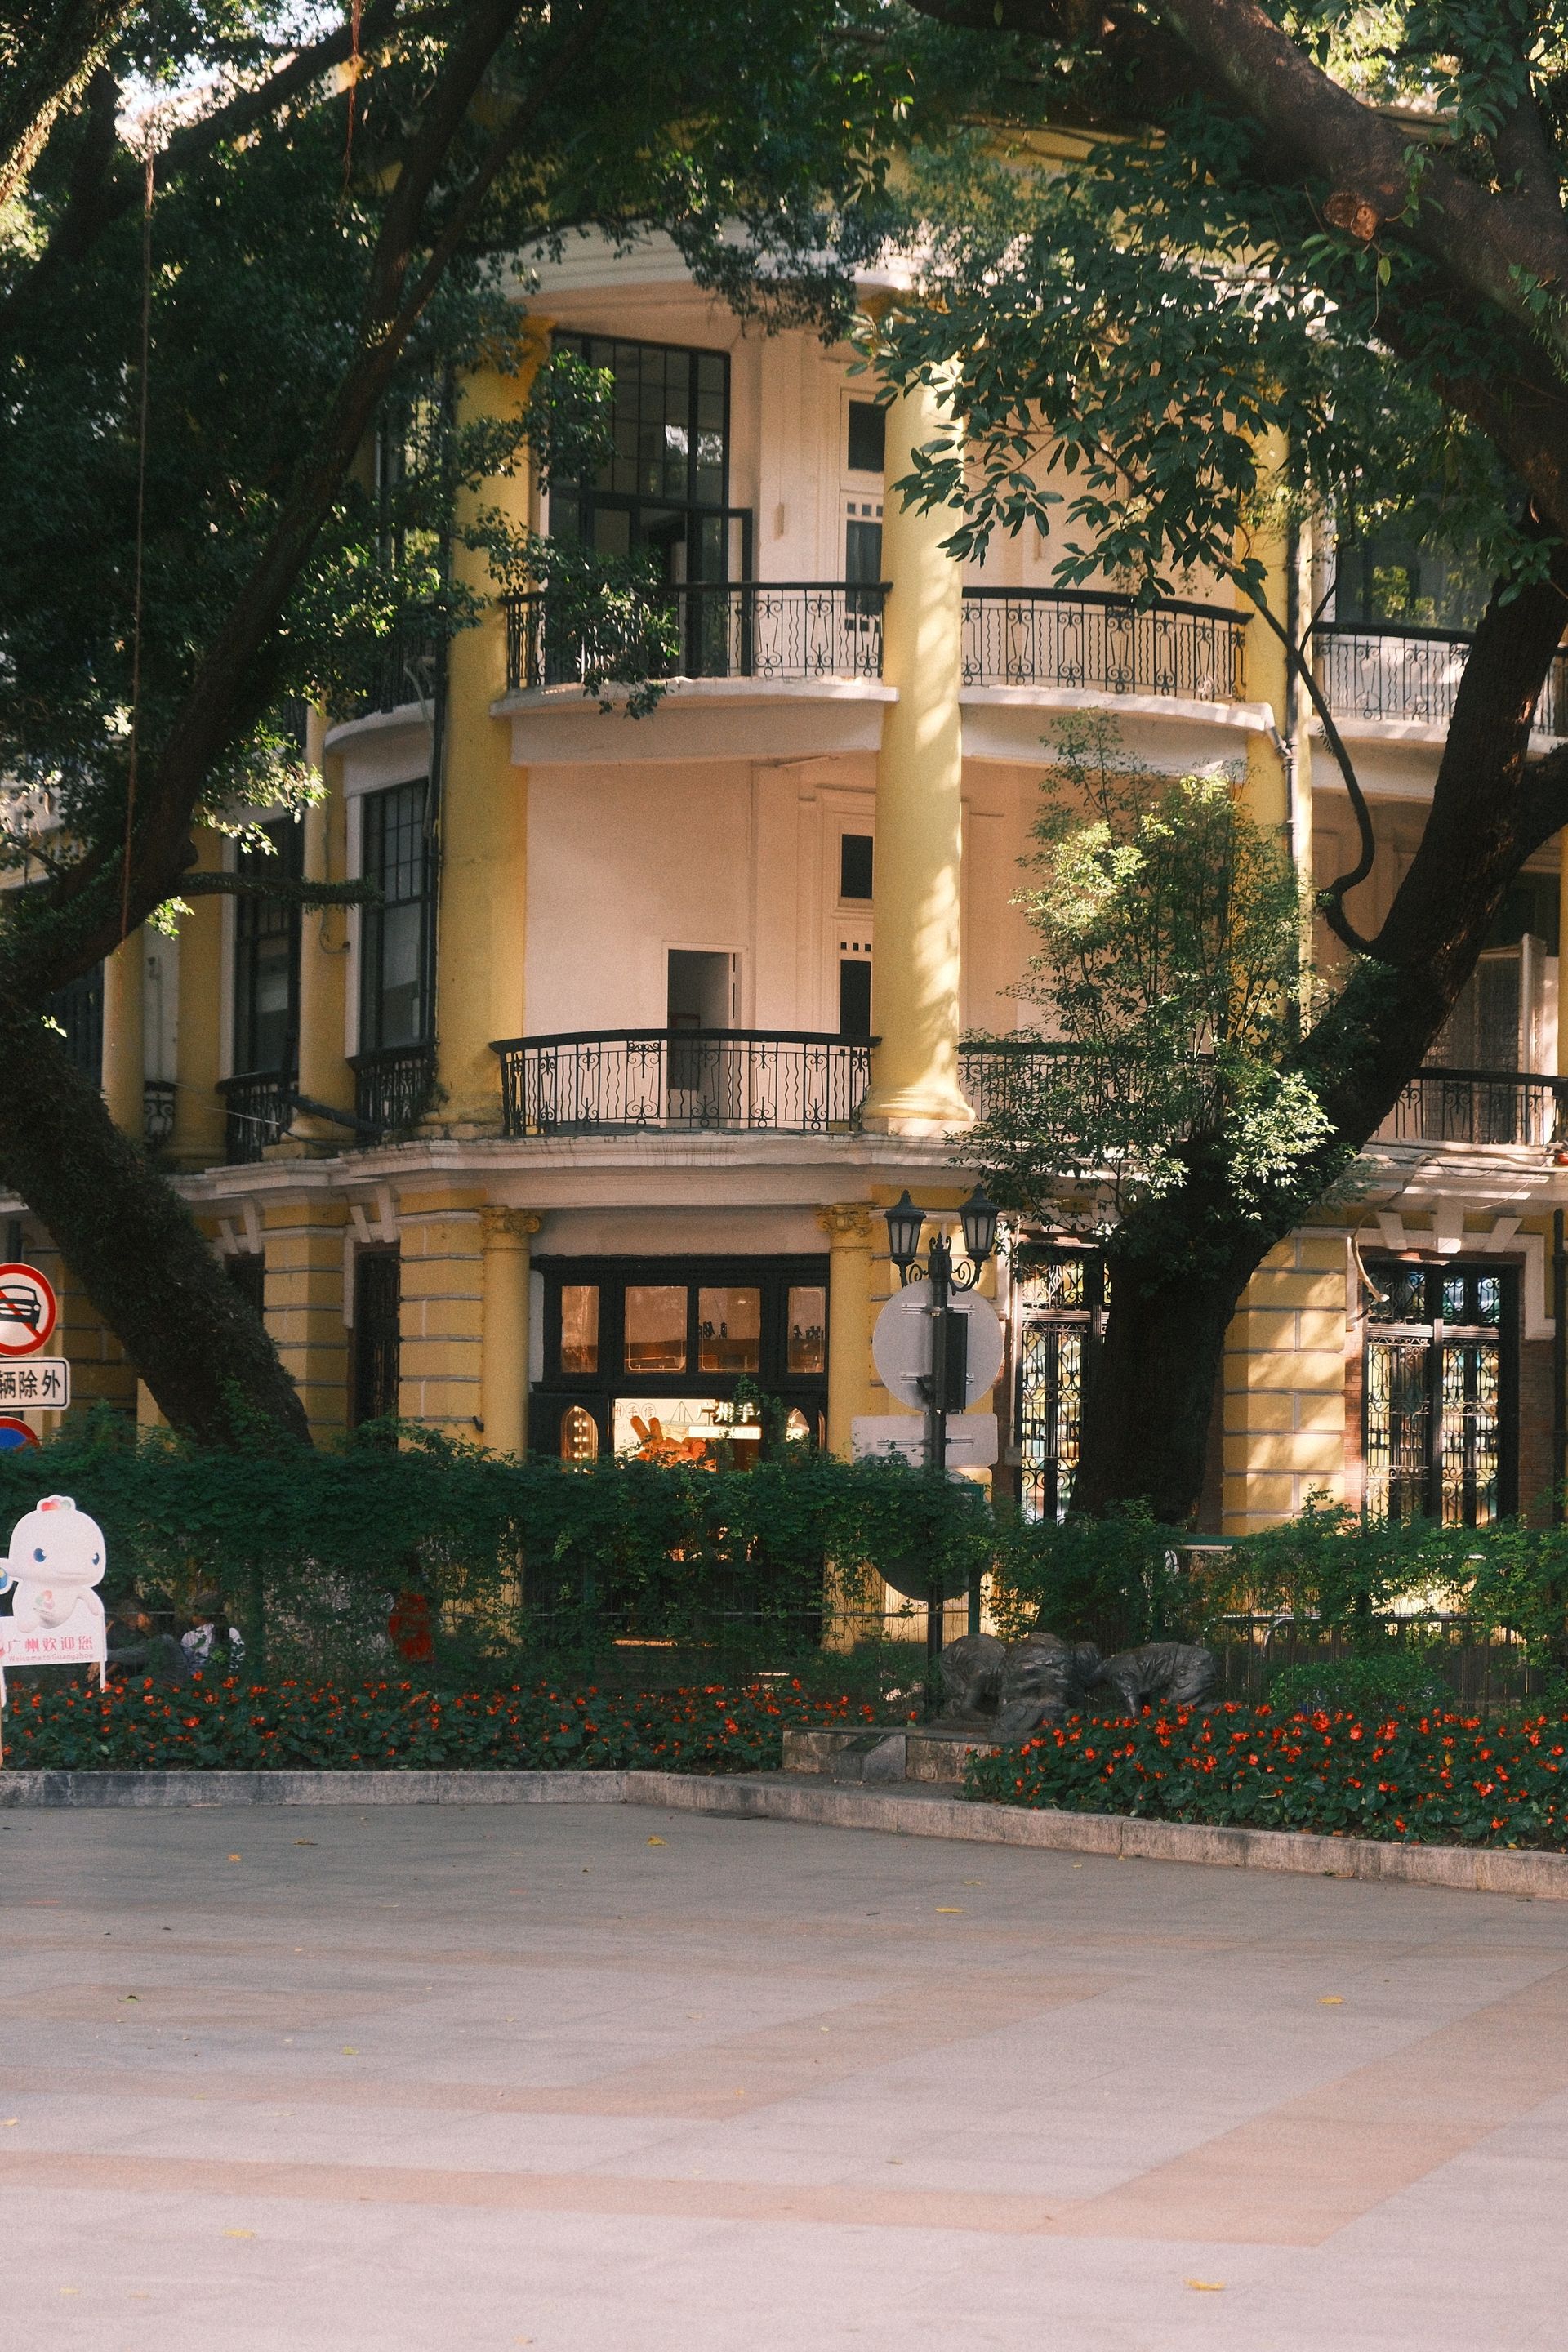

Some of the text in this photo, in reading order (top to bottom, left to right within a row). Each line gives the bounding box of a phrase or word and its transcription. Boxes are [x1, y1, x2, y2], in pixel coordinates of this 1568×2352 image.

[696, 1401, 761, 1423] 广州手
[7, 1636, 92, 1653] 广州欢迎您
[9, 1654, 41, 1662] Welcome
[51, 1653, 94, 1661] Guangzhou
